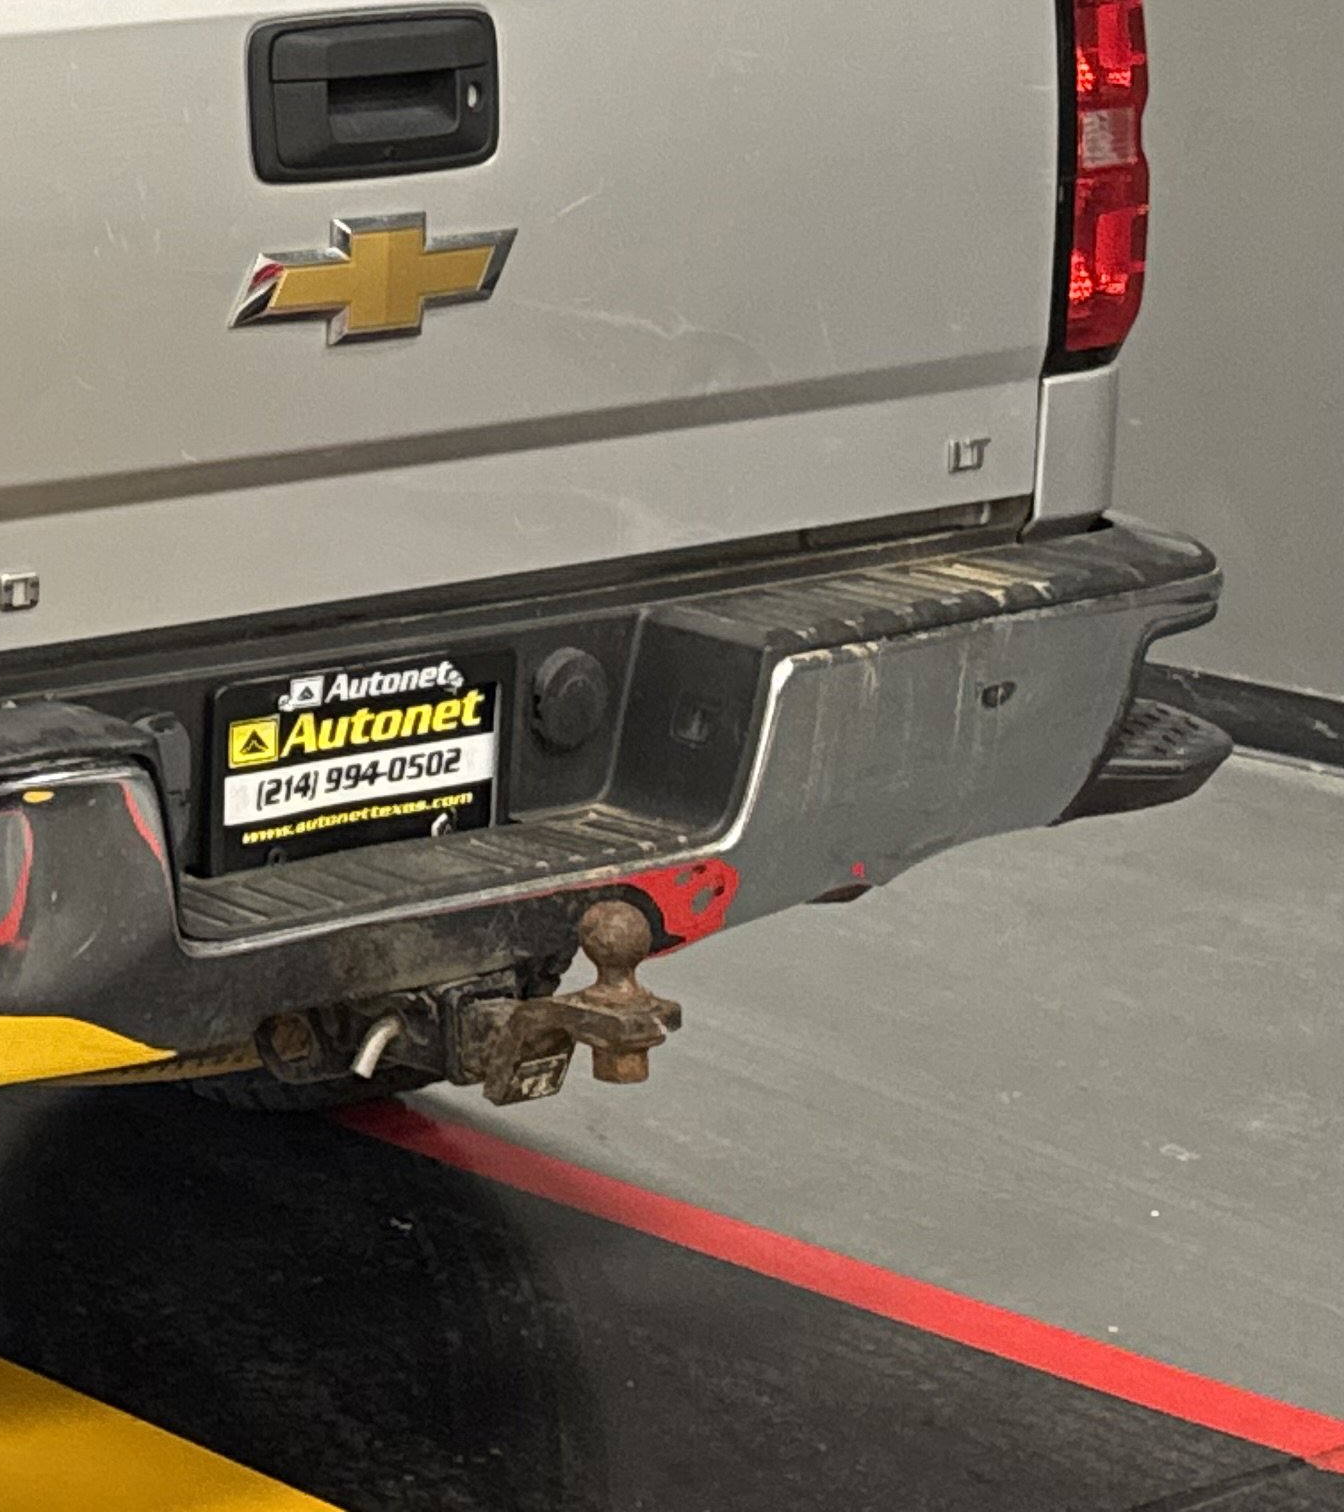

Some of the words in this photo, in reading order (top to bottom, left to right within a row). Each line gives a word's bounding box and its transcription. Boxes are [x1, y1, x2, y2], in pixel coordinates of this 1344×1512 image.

[324, 660, 454, 703] Autonet
[280, 688, 485, 759] Autonet
[256, 769, 318, 811] (214)
[325, 747, 462, 794] 994-0502
